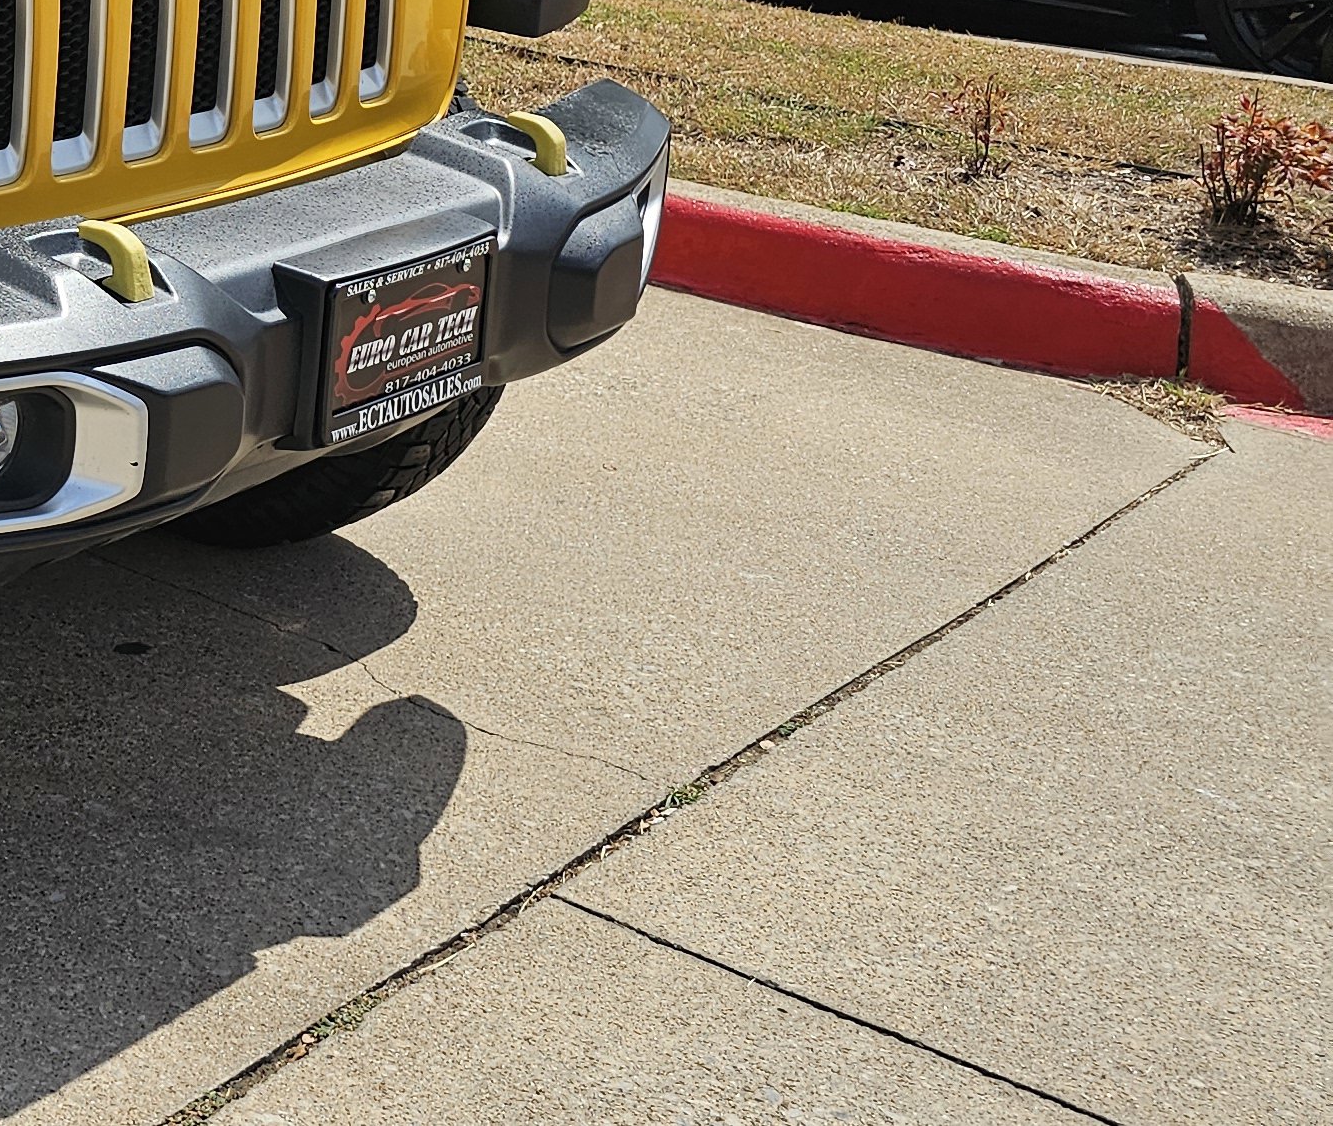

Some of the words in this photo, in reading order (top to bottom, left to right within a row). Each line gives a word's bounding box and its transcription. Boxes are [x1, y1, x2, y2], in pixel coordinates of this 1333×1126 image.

[346, 278, 375, 298] SALES
[376, 277, 384, 289] &
[385, 263, 425, 286] SERVICE
[433, 241, 490, 271] 817-404-4033
[346, 334, 396, 375] EURO
[398, 321, 433, 356] CAR
[435, 305, 479, 344] TECH
[386, 349, 427, 371] european
[428, 332, 474, 358] automotive
[384, 352, 472, 394] 817-404-4033
[330, 372, 482, 443] www.ECTAUTOSALES.com
